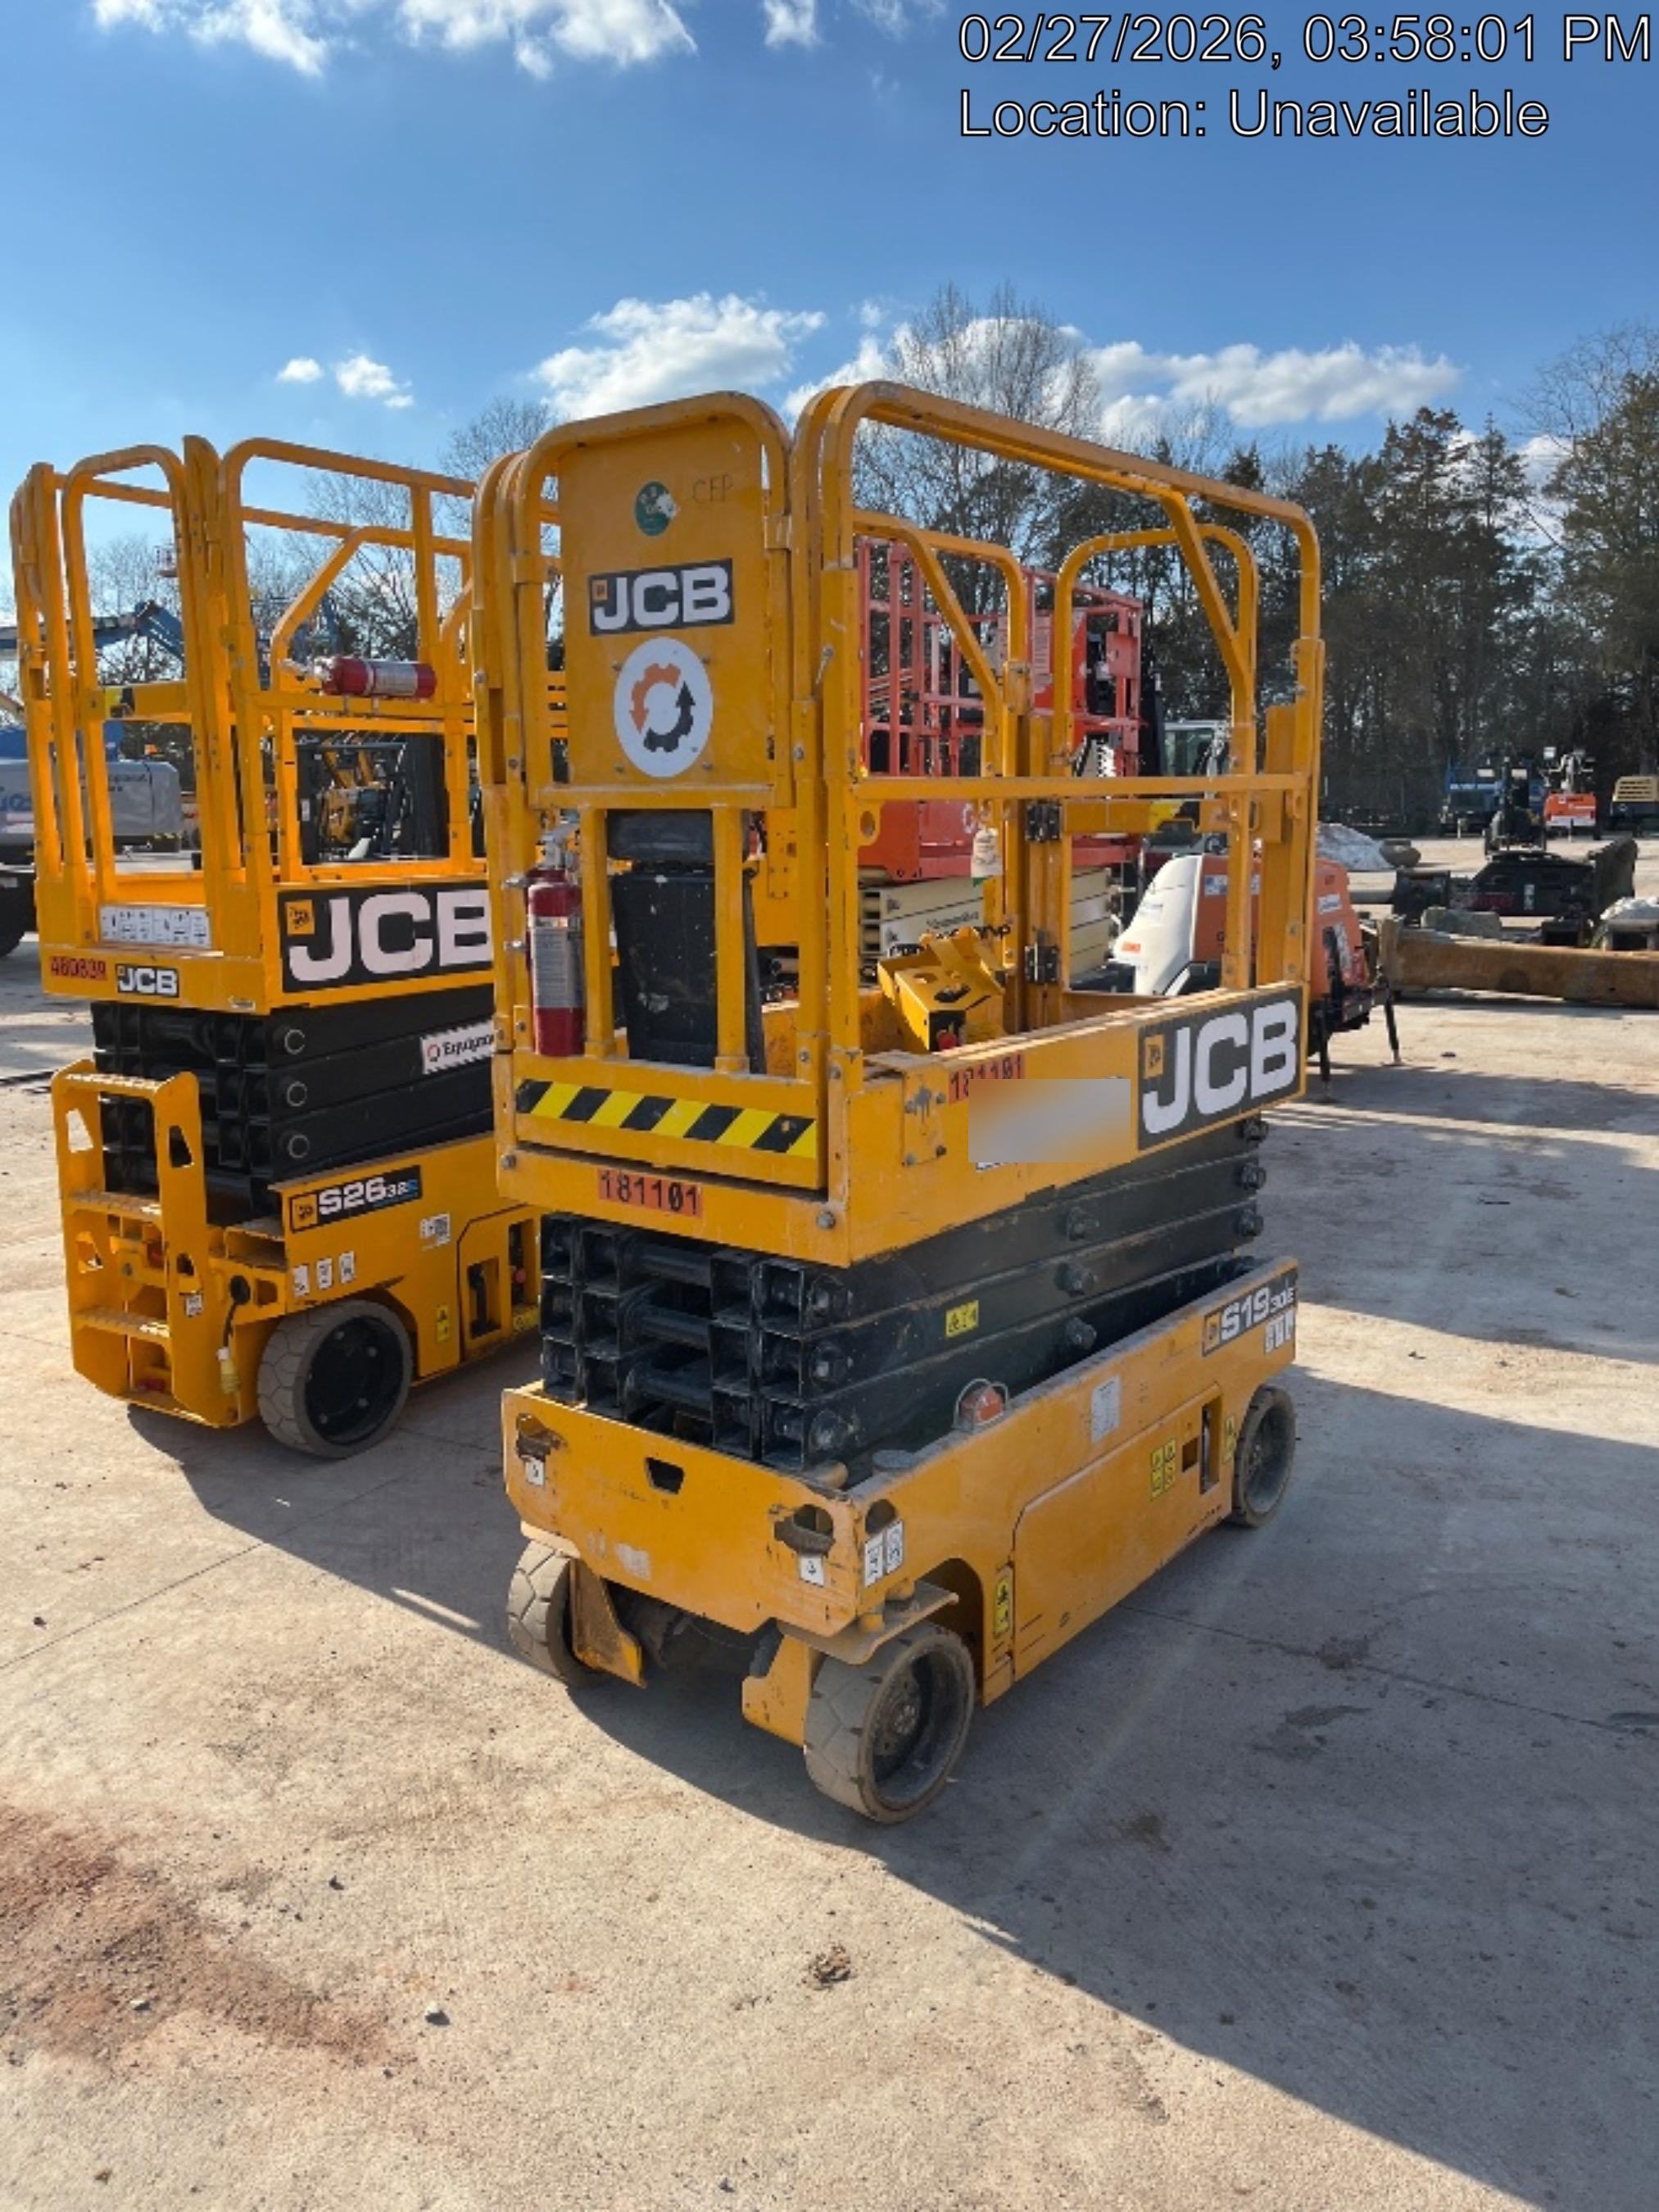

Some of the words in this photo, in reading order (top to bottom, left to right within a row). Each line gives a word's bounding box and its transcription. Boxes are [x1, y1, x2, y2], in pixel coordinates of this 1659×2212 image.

[593, 566, 730, 631] JCB
[289, 889, 493, 981] JCB
[119, 967, 177, 995] JCB
[1142, 999, 1298, 1134] JCB
[601, 1170, 696, 1215] 181101
